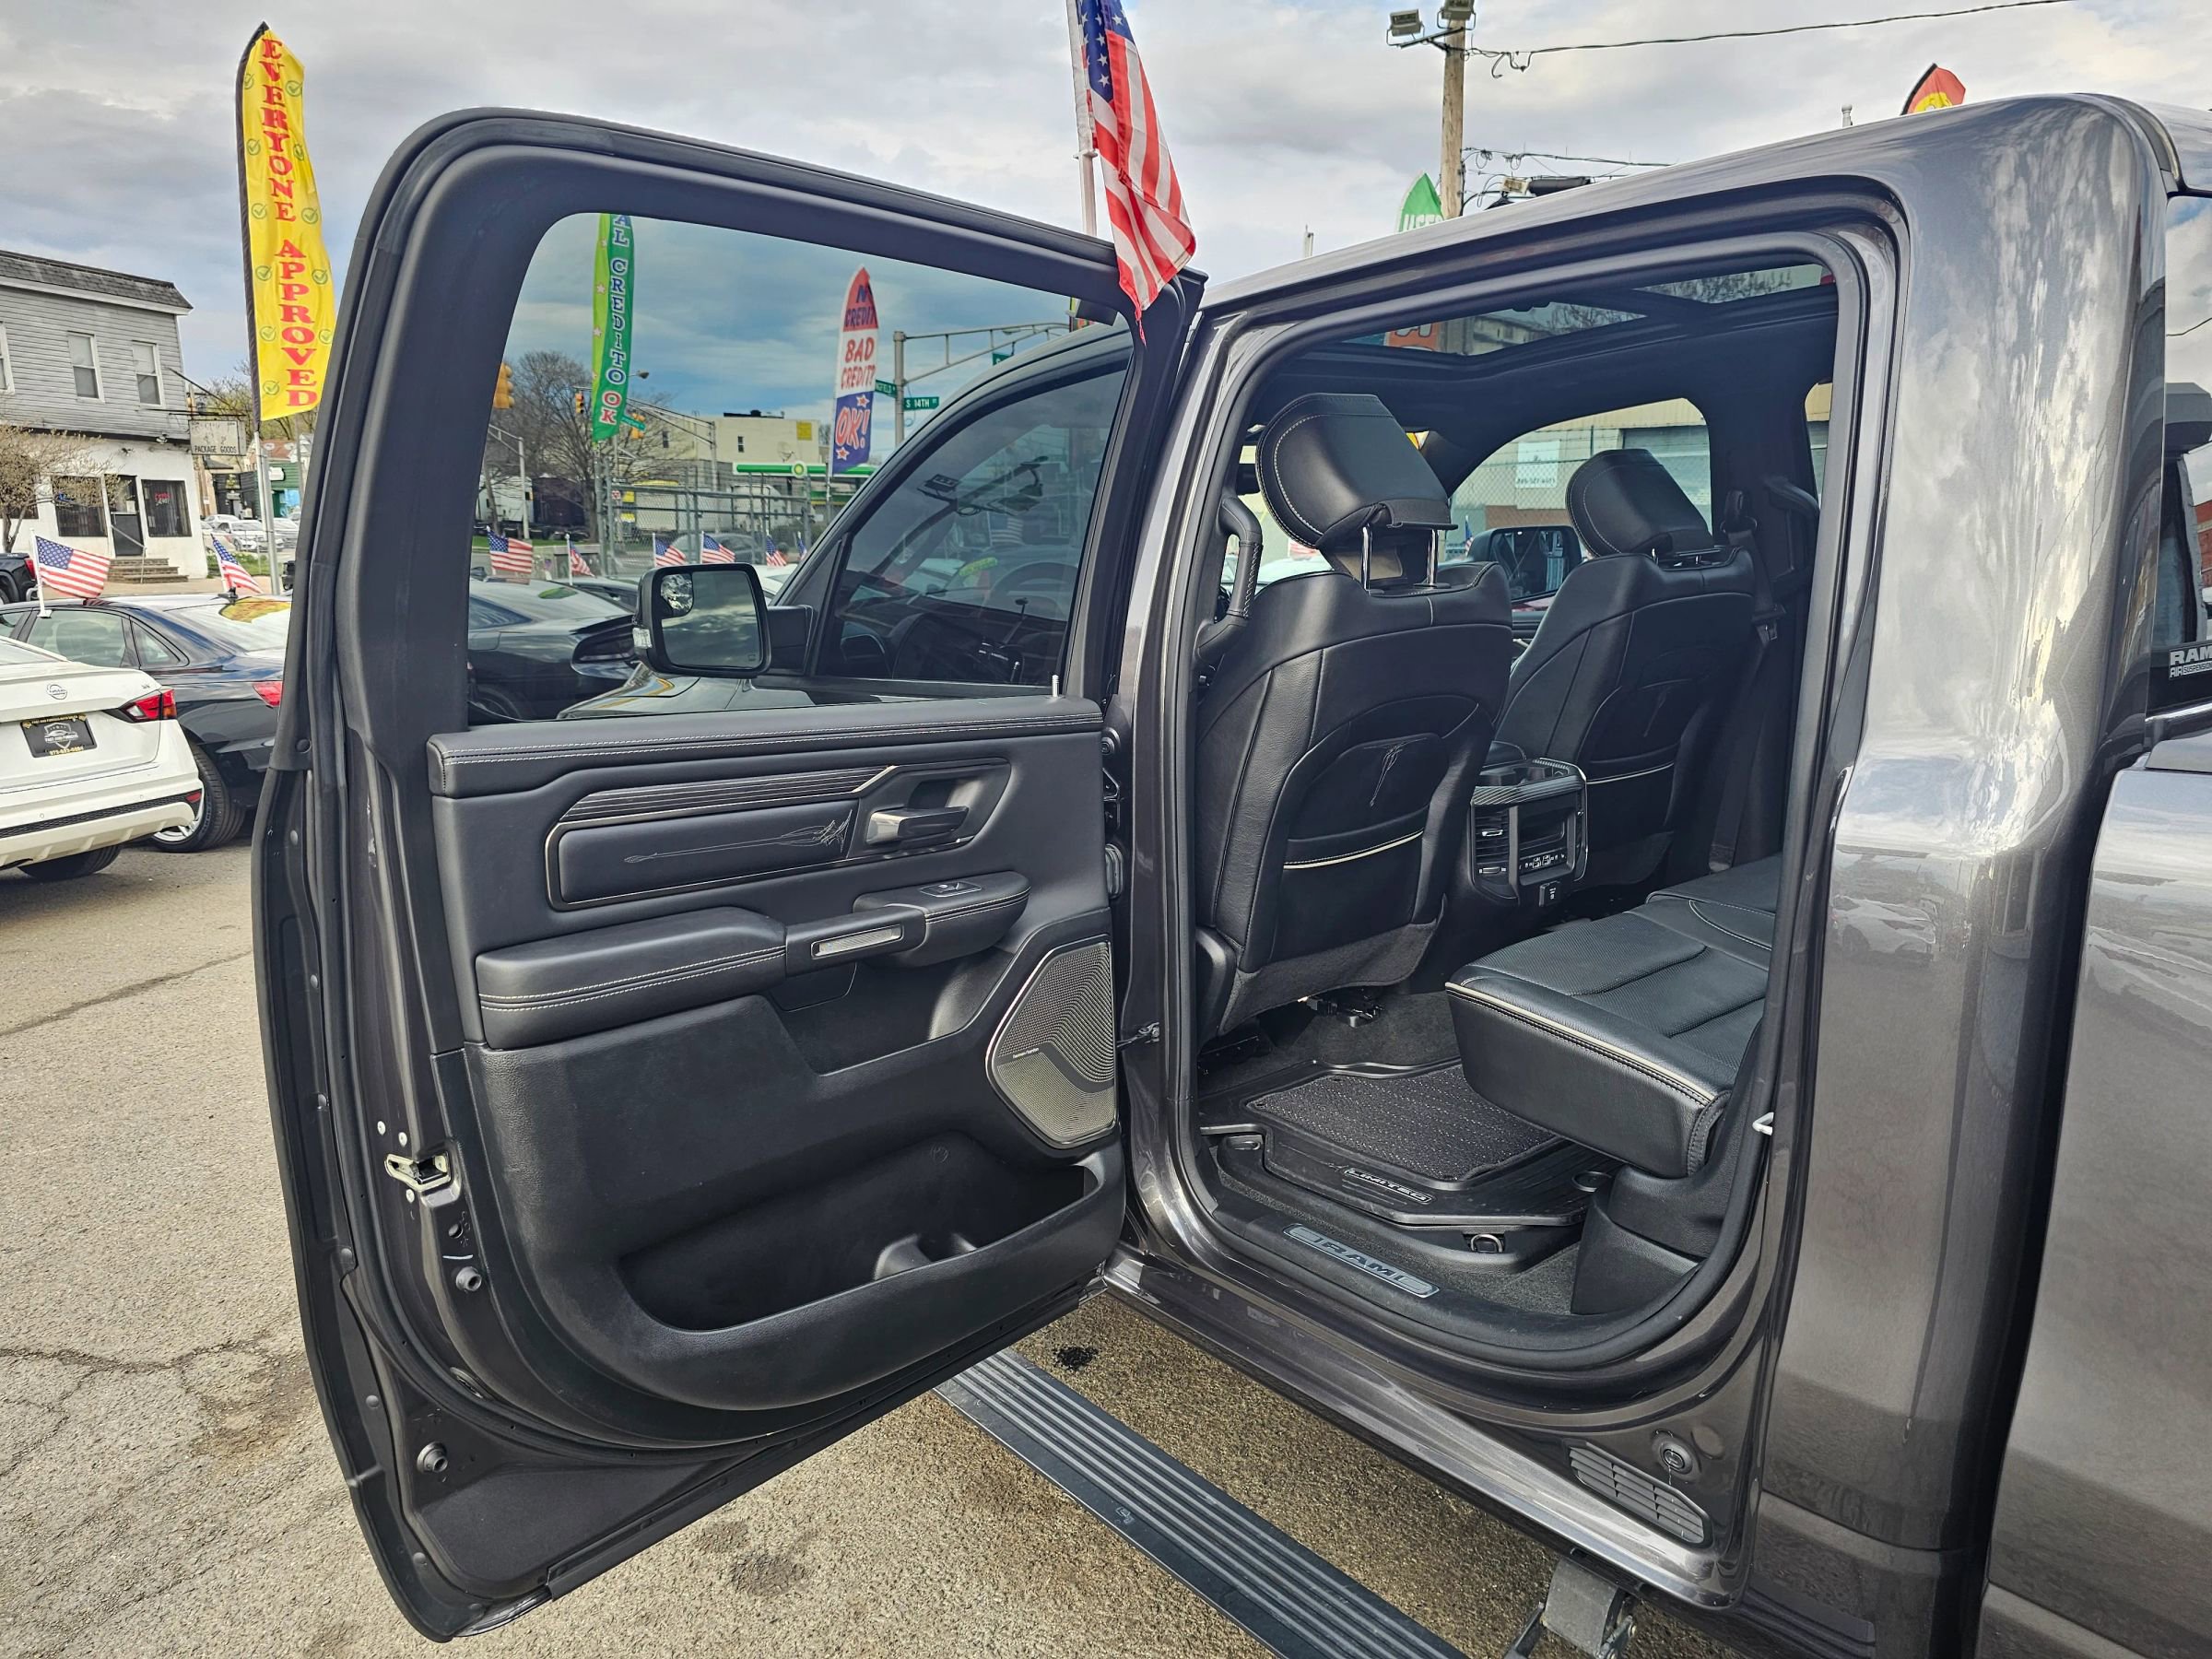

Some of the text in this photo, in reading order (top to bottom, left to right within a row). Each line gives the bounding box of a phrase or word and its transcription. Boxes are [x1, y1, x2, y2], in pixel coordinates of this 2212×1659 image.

[259, 39, 318, 406] EVERYONE APPROVED
[606, 258, 629, 385] CREDITO
[845, 336, 875, 363] BAD
[841, 364, 876, 389] CREDIT?
[599, 391, 623, 425] OK
[906, 399, 911, 408] S
[914, 398, 930, 408] 14TH
[835, 406, 870, 450] OK!
[194, 445, 237, 453] PACKAGE GOODS
[2171, 645, 2212, 665] RAM
[2171, 665, 2183, 678] AIR
[1348, 1169, 1429, 1201] LIMITED
[1320, 1242, 1396, 1277] RAM
